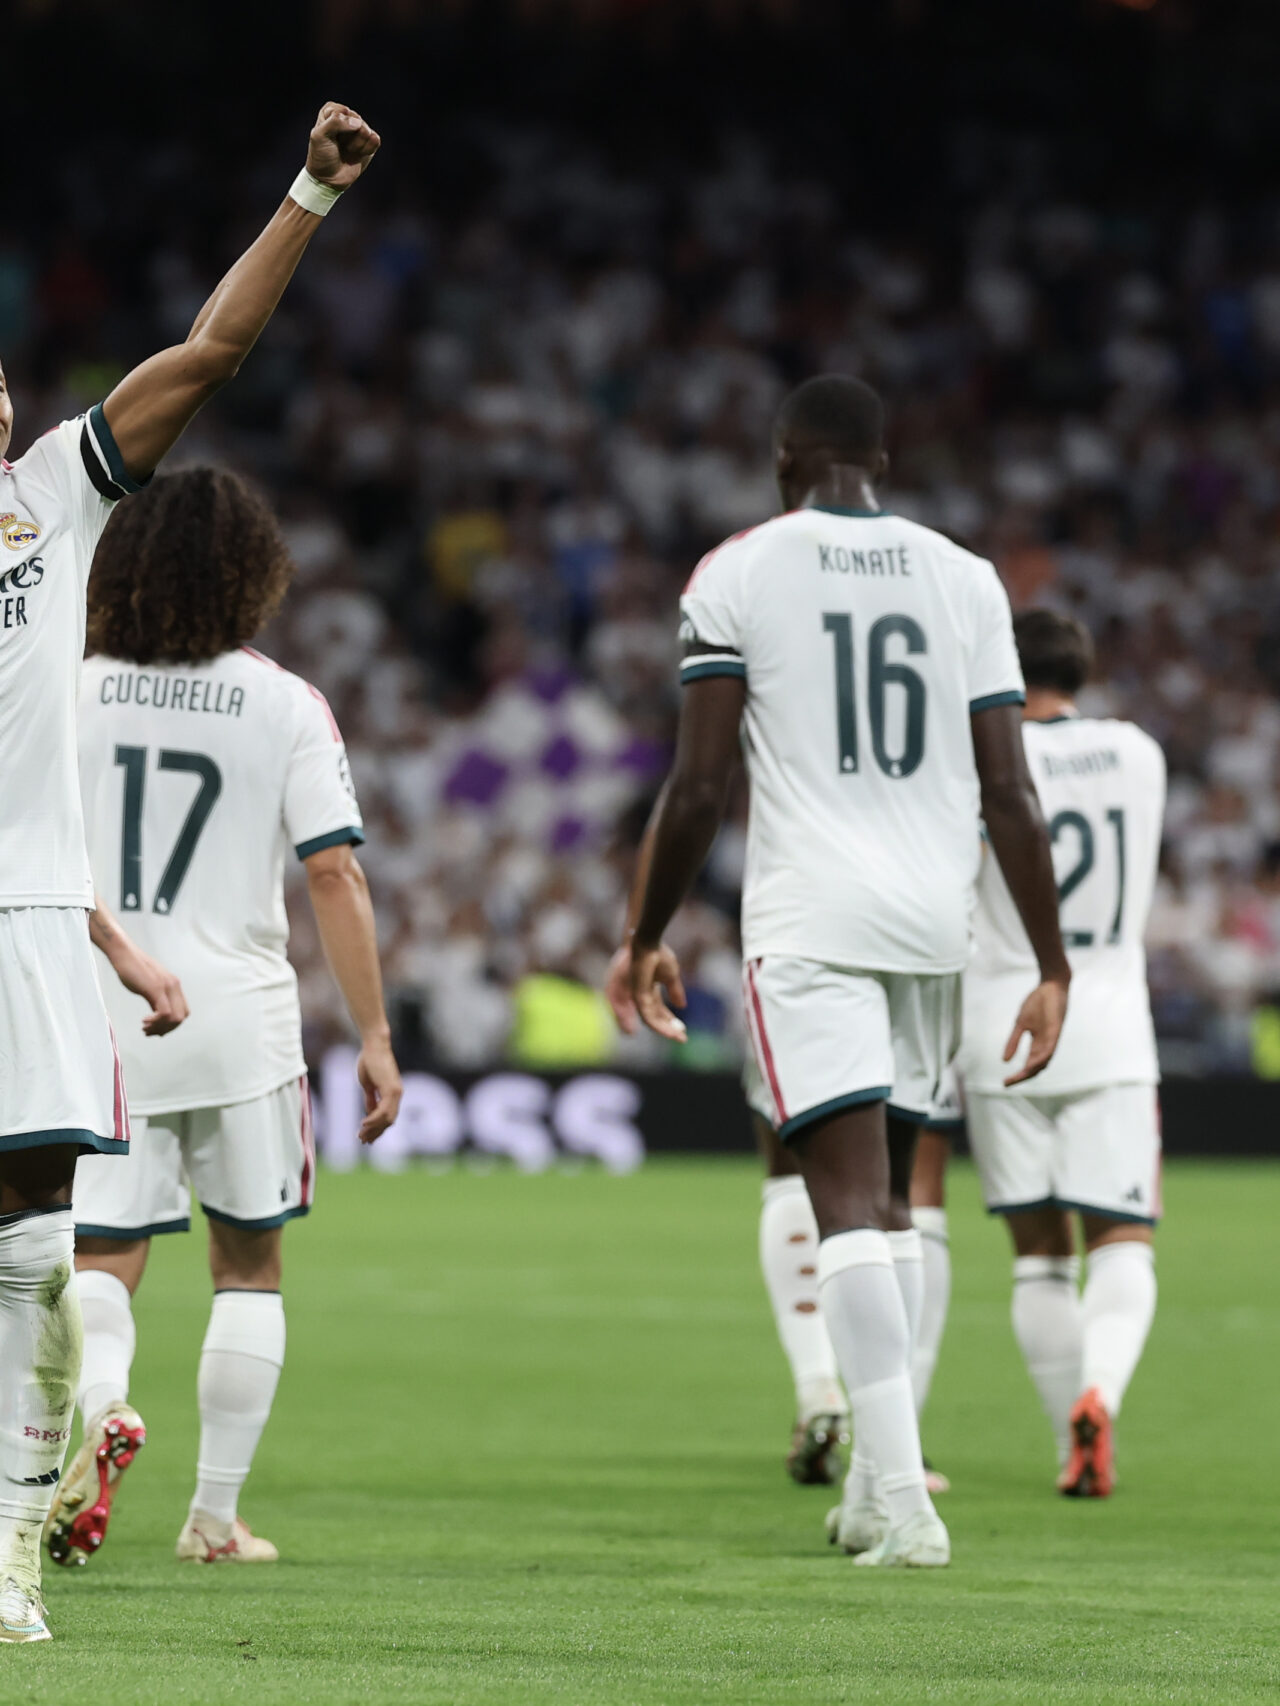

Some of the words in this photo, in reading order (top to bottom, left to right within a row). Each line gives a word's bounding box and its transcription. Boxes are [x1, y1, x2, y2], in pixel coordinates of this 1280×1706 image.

[818, 541, 912, 577] KONATÉ
[100, 673, 245, 717] CUCURELLA
[822, 612, 928, 779] 16
[115, 744, 224, 915] 17
[1048, 808, 1124, 947] 21
